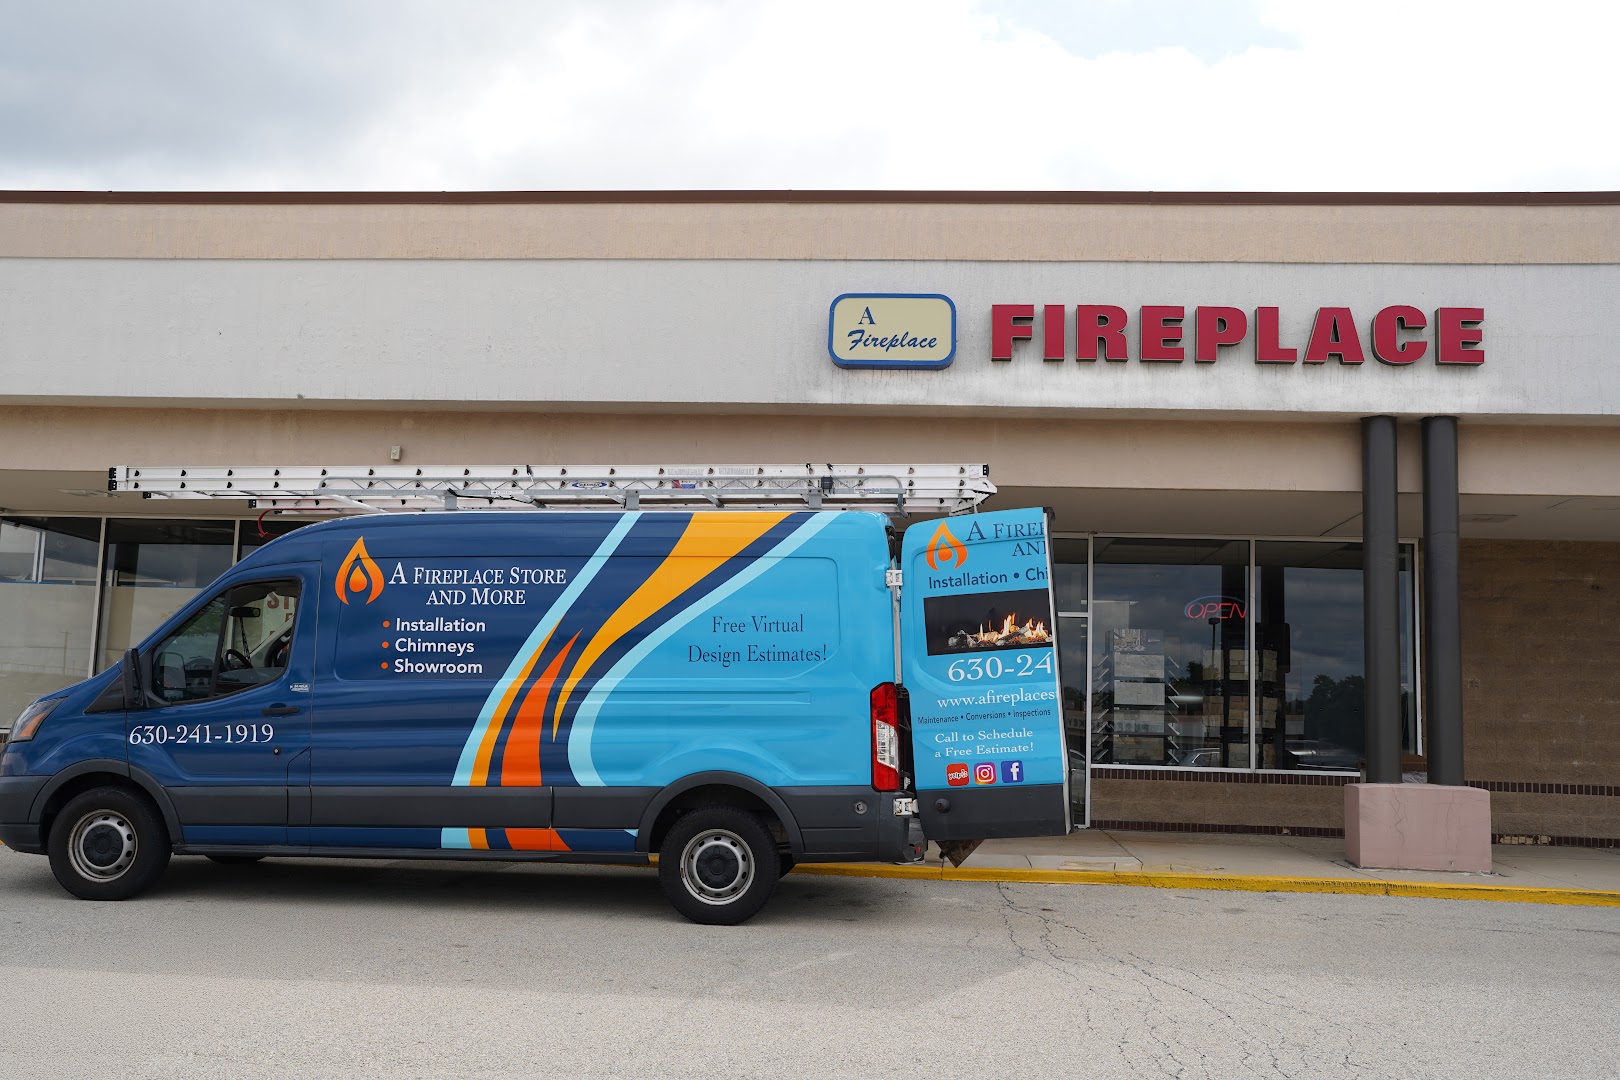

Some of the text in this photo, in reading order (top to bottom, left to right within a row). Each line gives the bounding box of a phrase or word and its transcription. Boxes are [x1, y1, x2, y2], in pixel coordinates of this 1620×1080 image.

[858, 306, 876, 325] A
[847, 329, 938, 352] Fireplace
[991, 303, 1485, 365] FIREPLACE
[964, 520, 987, 542] A
[388, 561, 567, 585] A FIREPLACE STORE
[928, 571, 1008, 589] Installation
[425, 588, 526, 605] AND MORE
[1187, 602, 1247, 619] OPEN
[396, 616, 486, 632] Installation
[712, 613, 804, 633] Free Virtual
[394, 637, 475, 656] Chimneys
[688, 643, 828, 668] Design Estimates!
[393, 658, 483, 674] Showroom
[947, 651, 1053, 682] 630-24
[937, 687, 1058, 709] www.afireplaces
[917, 708, 1051, 725] Maintenance Conversions Inspections
[129, 723, 274, 745] 630-241-1919
[934, 727, 1034, 743] Call to Schedule
[934, 741, 1035, 758] a Free Estimate!
